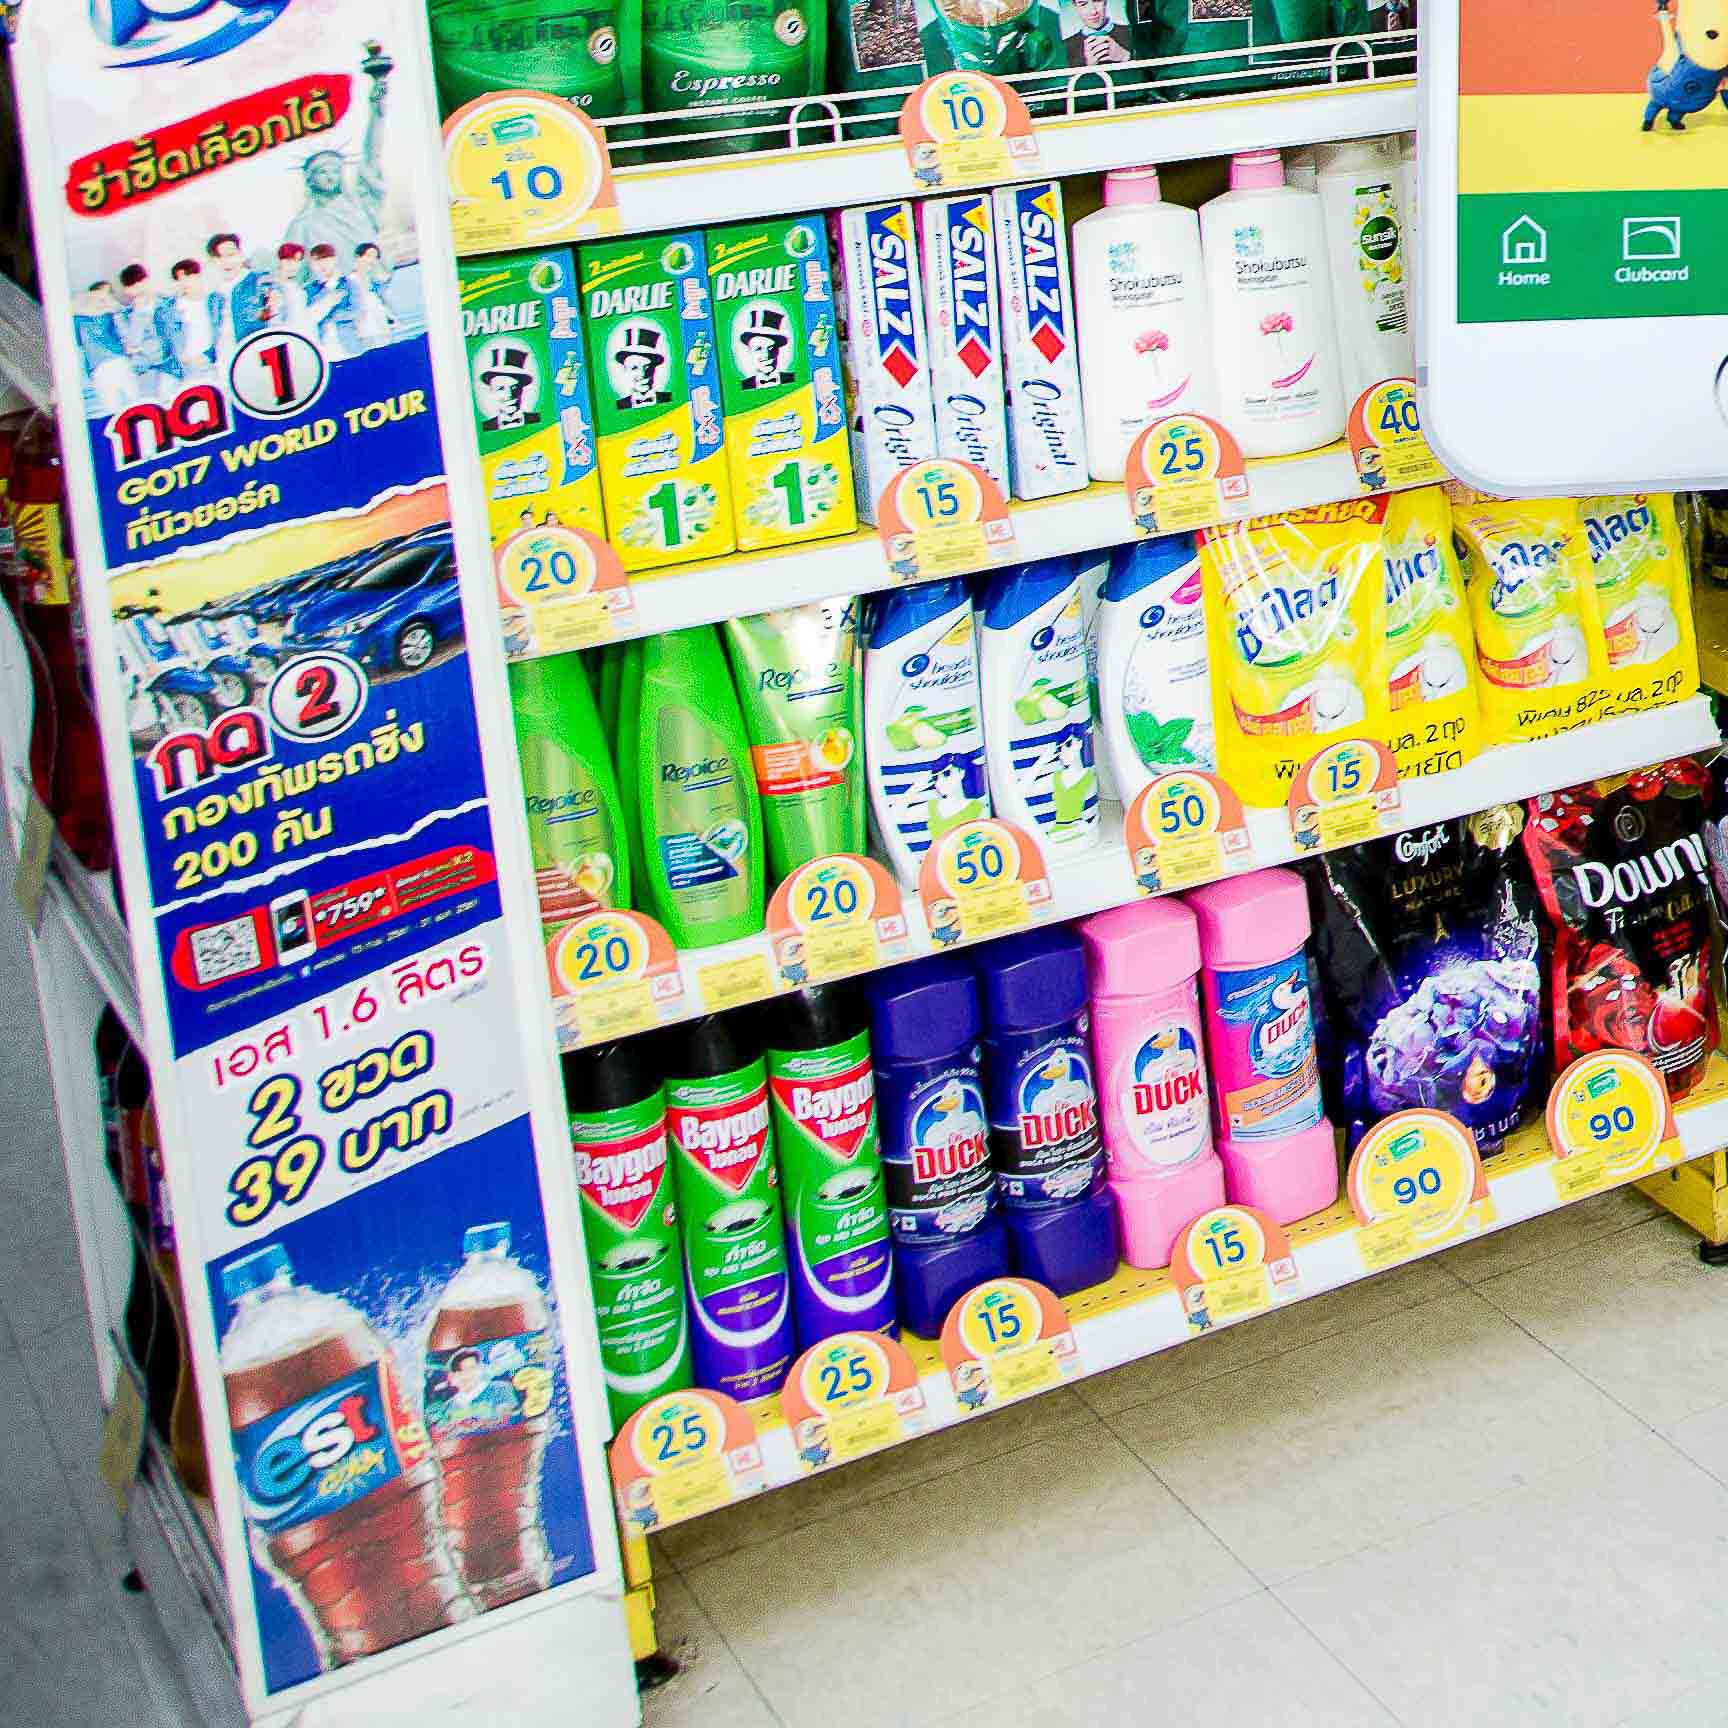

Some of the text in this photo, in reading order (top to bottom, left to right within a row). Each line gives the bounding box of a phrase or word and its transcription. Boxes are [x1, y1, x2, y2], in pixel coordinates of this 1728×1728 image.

[671, 70, 782, 93] Espresso
[944, 96, 985, 132] 10
[490, 166, 563, 201] 10
[715, 263, 798, 302] DARLIE
[950, 222, 991, 328] SALZ
[1019, 210, 1062, 313] SALZ
[1498, 270, 1551, 288] Home
[1614, 265, 1690, 284] Clubcard
[590, 280, 675, 320] DARLIE
[870, 233, 914, 339] SALZ
[112, 345, 296, 468] กด 1
[1020, 378, 1077, 468] Original
[1379, 400, 1419, 434] 40
[117, 387, 429, 509] GOT7 WORLD TOUR
[1158, 437, 1205, 476] 25
[648, 481, 683, 549] 1
[773, 462, 807, 528] 1
[916, 481, 959, 518] 15
[520, 552, 577, 593] 20
[152, 667, 340, 798] กด 2
[660, 753, 730, 783] Rejoice
[1327, 758, 1361, 795] 15
[526, 784, 596, 818] Rejoice
[1159, 793, 1205, 833] 50
[173, 807, 336, 892] 200 คัน
[956, 846, 1004, 886] 50
[1394, 822, 1451, 867] Comfort
[807, 879, 858, 923] 20
[574, 936, 632, 981] 20
[210, 944, 486, 1090] เอส 1.6 ลิตร
[247, 1028, 434, 1152] 2 ขวด
[790, 1072, 875, 1121] Baygon
[1132, 1067, 1205, 1117] DUCK
[680, 1099, 770, 1152] Baygon
[1019, 1097, 1099, 1151] DUCK
[1589, 1106, 1635, 1140] 90
[226, 1087, 455, 1228] 39 บาท
[575, 1135, 668, 1187] Baygon
[911, 1131, 990, 1185] DUCK
[1392, 1166, 1442, 1205] 90
[1204, 1229, 1246, 1270] 15
[978, 1303, 1023, 1343] 15
[819, 1357, 873, 1401] 25
[651, 1415, 706, 1462] 25
